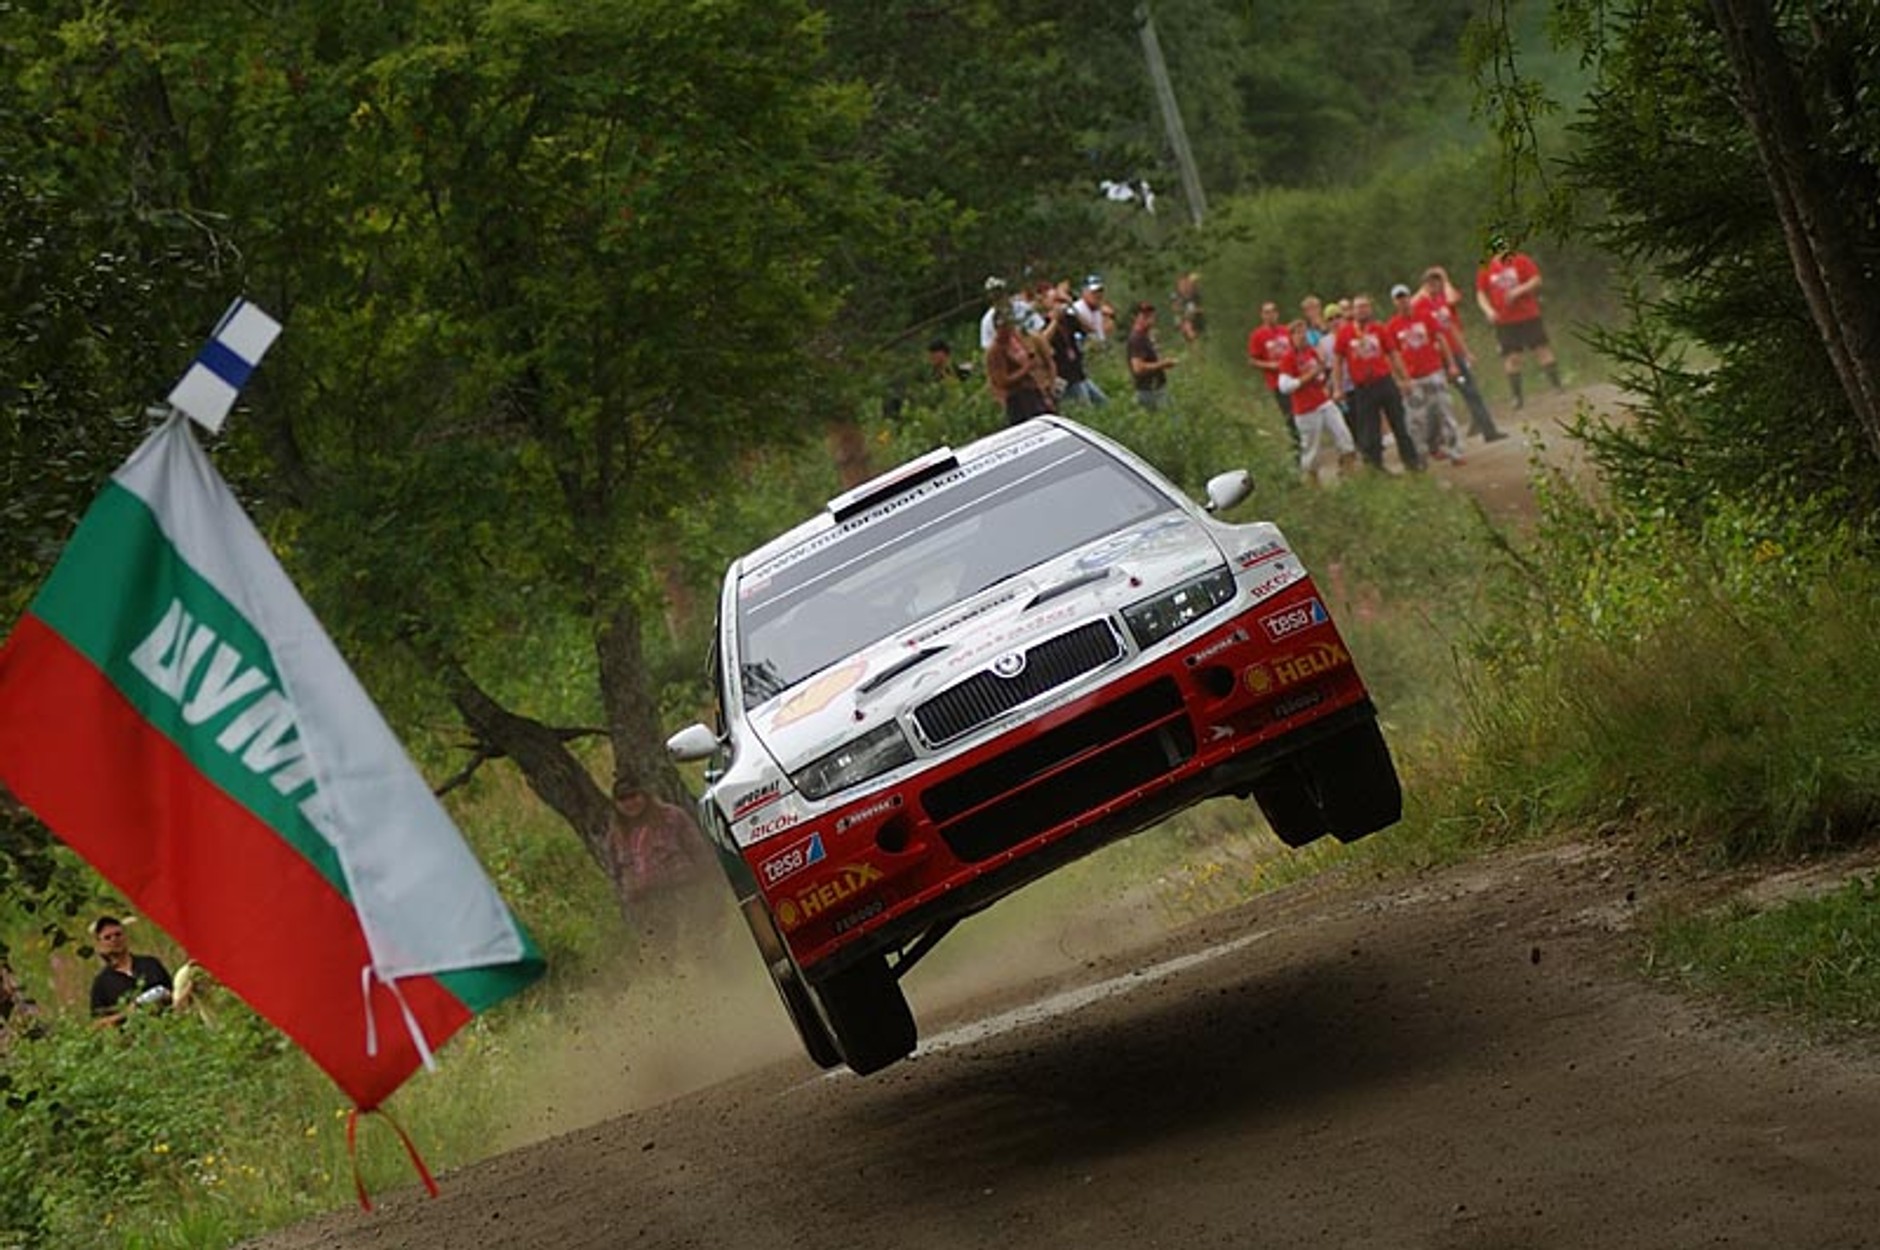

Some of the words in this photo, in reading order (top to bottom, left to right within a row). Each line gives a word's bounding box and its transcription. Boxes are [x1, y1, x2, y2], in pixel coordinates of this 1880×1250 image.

[1267, 608, 1309, 636] tesa
[1274, 643, 1349, 685] HELIX
[128, 597, 340, 848] ШУМ
[750, 813, 799, 840] RICOH
[764, 849, 803, 882] tesa
[799, 861, 884, 919] HELIX
